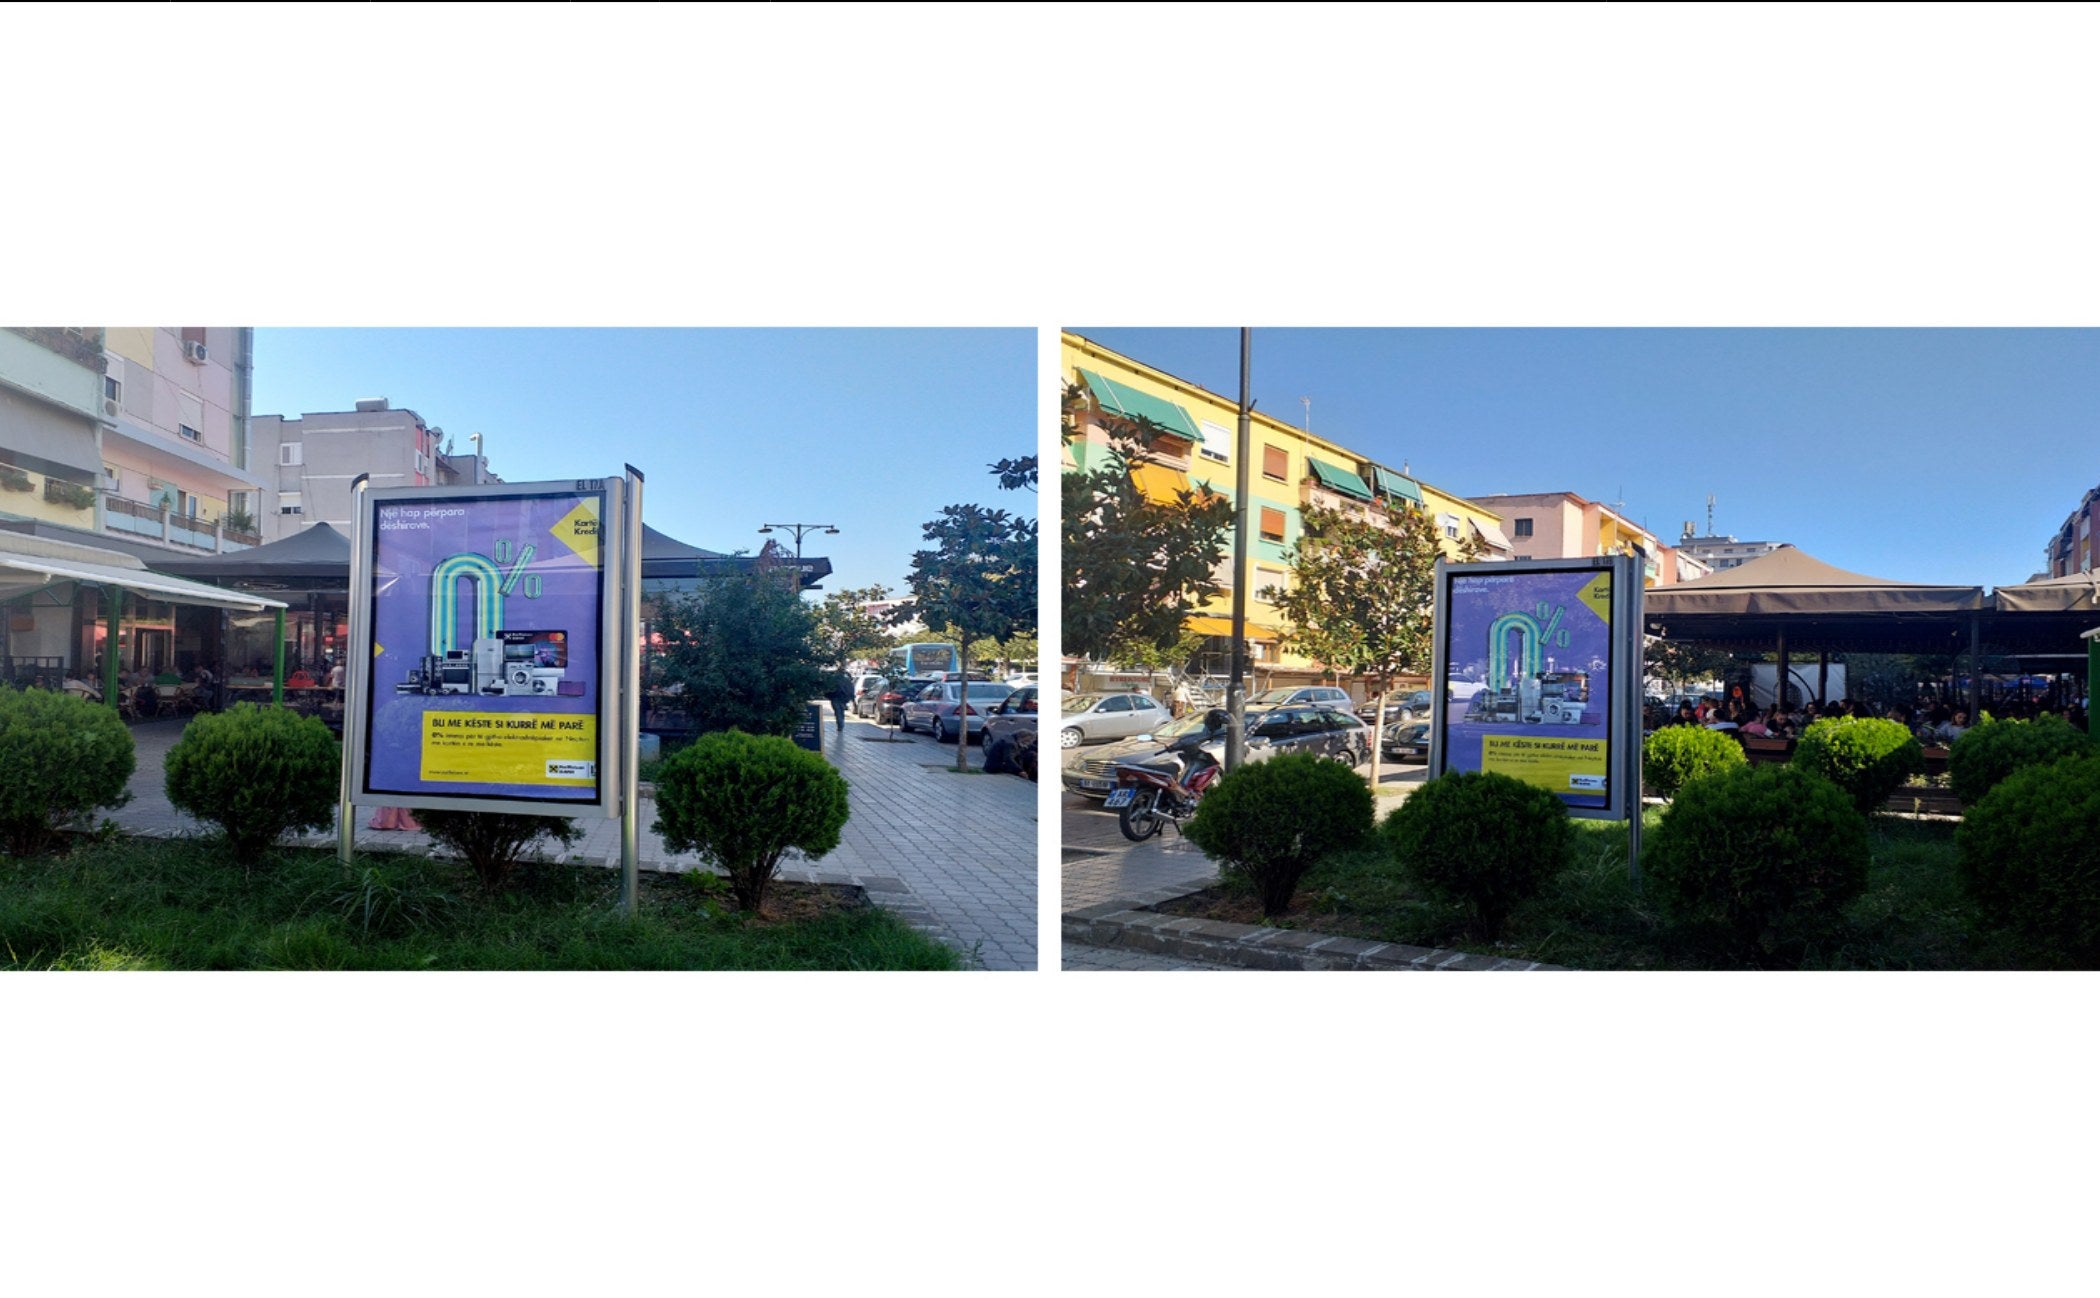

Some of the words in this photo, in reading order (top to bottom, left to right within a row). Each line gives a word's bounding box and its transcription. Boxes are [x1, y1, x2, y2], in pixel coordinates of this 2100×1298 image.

[401, 508, 420, 519] hap
[447, 719, 462, 729] ME
[465, 718, 492, 729] KËSTE
[495, 720, 504, 729] SI
[506, 719, 537, 730] KURRË
[541, 720, 556, 730] MË
[559, 720, 584, 731] PARË
